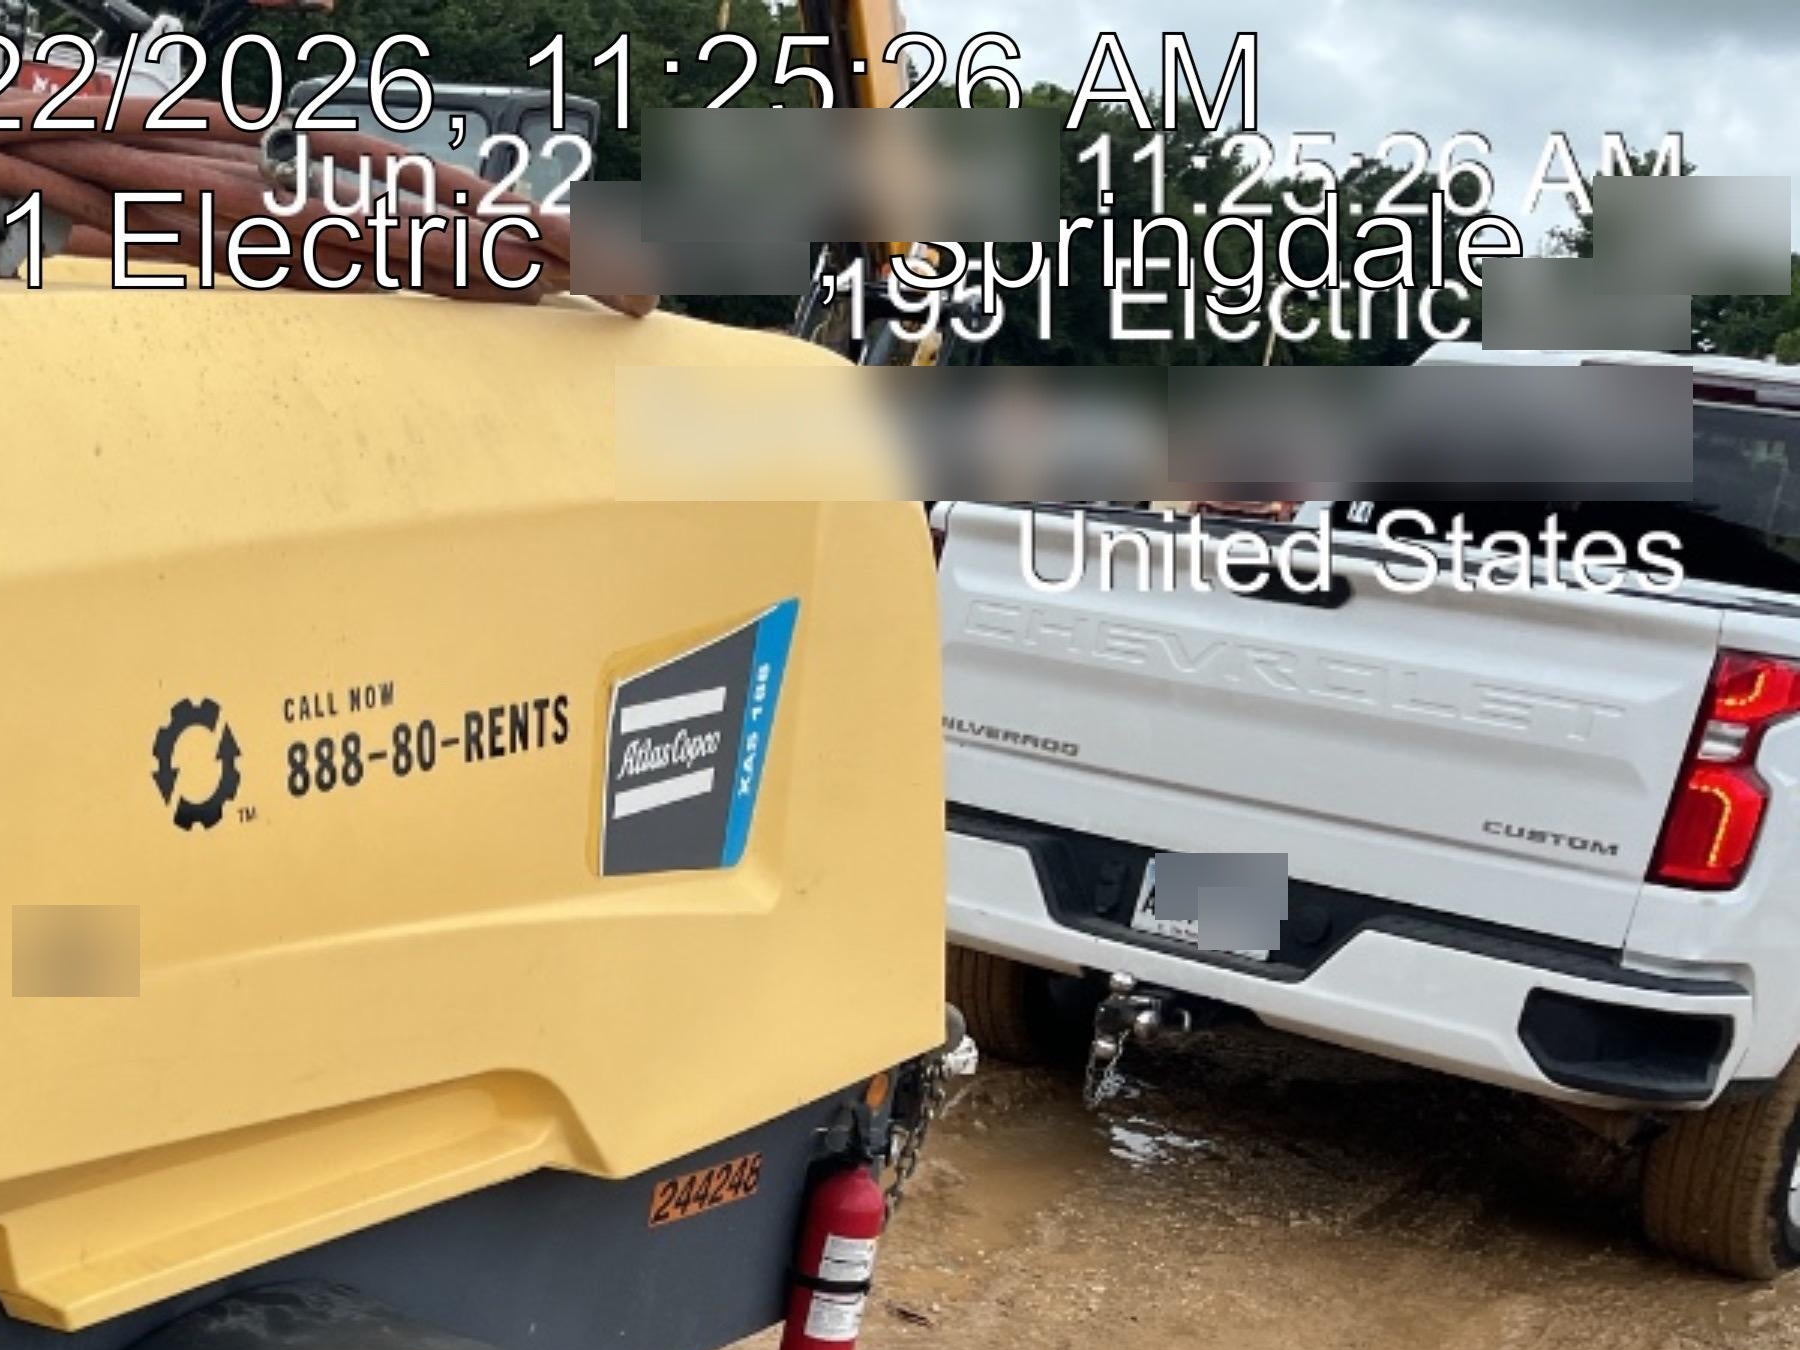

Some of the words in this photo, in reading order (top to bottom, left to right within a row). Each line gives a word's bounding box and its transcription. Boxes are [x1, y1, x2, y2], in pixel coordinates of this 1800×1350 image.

[284, 692, 339, 724] CALL
[349, 680, 395, 713] NOW
[963, 600, 1626, 743] CHEVROLET
[286, 694, 570, 798] 888-80-RENTS
[1482, 820, 1620, 857] CUSTOM
[651, 1151, 763, 1224] 244248
